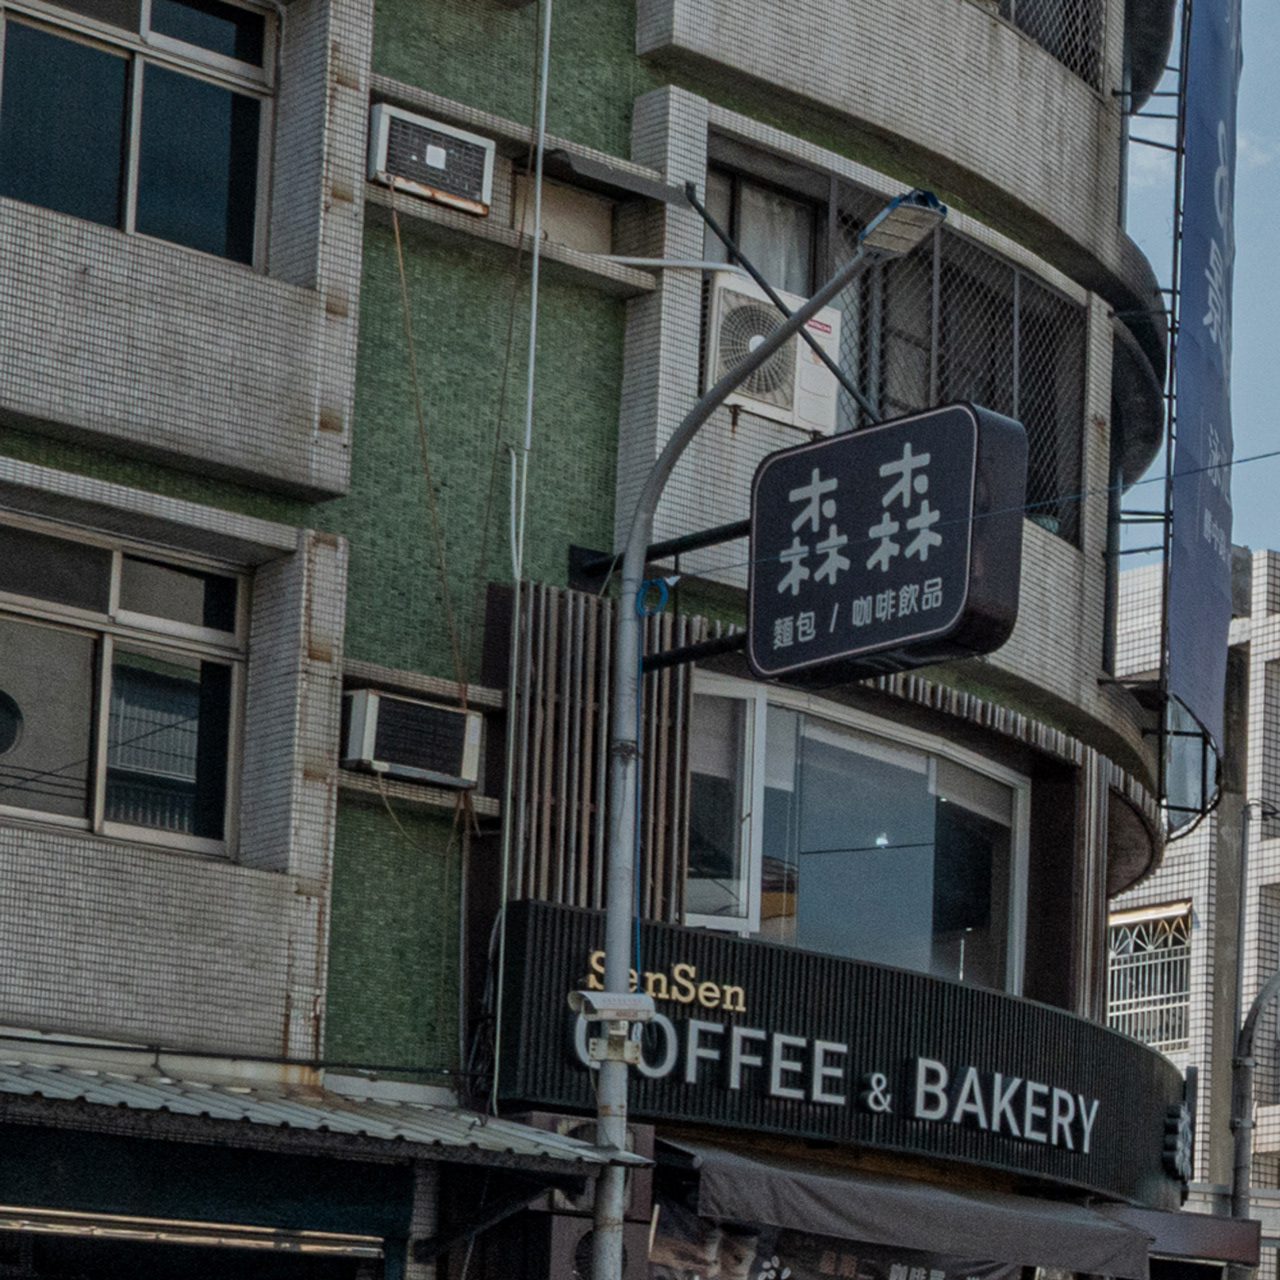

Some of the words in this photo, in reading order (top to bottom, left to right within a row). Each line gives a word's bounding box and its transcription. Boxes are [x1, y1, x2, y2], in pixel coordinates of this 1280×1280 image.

[777, 442, 942, 596] 森森
[772, 611, 816, 650] 麵包
[852, 577, 942, 627] 咖啡飲品
[868, 1072, 893, 1112] &
[915, 1057, 1101, 1156] BAKERY
